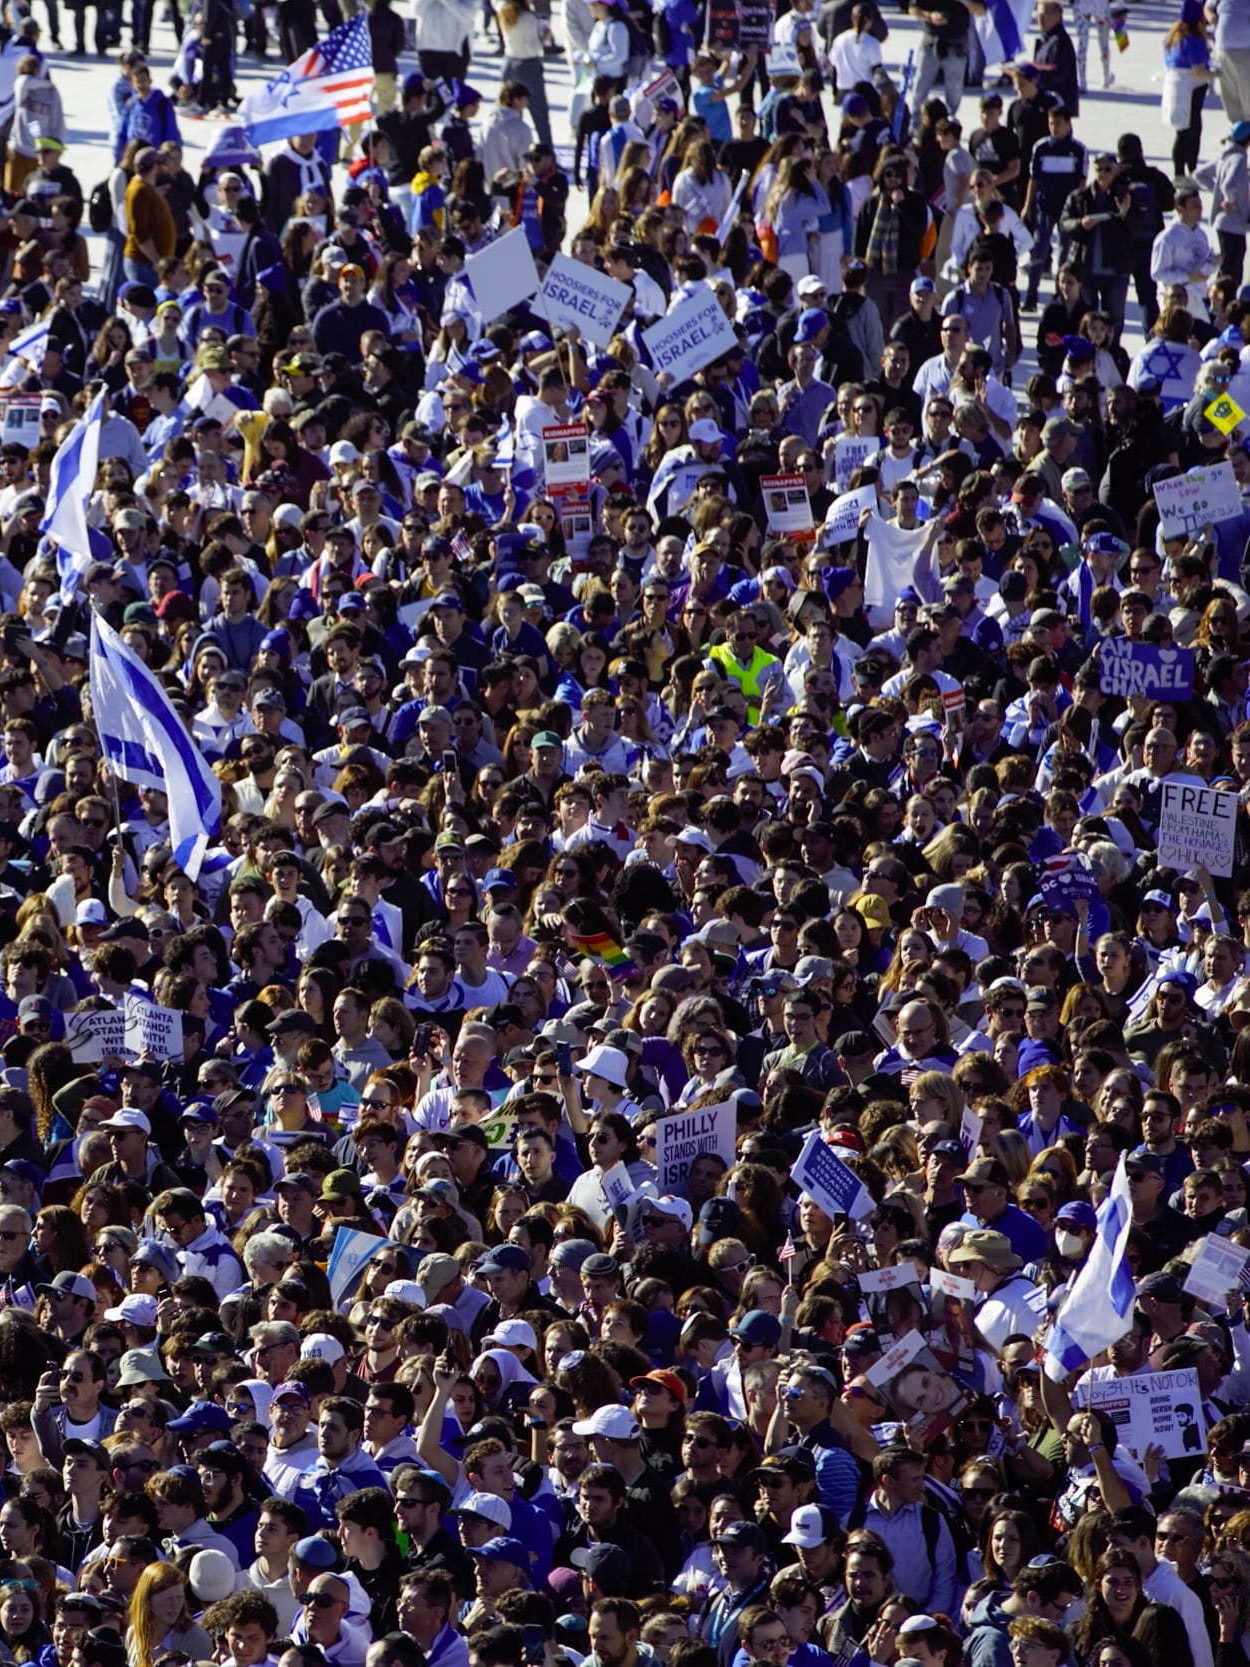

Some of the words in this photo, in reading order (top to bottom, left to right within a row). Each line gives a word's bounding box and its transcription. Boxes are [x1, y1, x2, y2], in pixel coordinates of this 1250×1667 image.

[550, 270, 600, 300] HOOSIERS
[600, 294, 622, 312] FOR
[543, 281, 597, 320] ISRAEL
[651, 316, 698, 354] HOOSIERS
[697, 303, 718, 321] FOR
[657, 327, 712, 369] ISRAEL
[544, 428, 586, 438] KIDNAPPED
[763, 478, 804, 487] KIDNAPPED
[1100, 638, 1133, 660] AM
[1100, 654, 1189, 689] YISRAEL
[1165, 784, 1230, 819] FREE
[1161, 821, 1189, 835] FROM
[1162, 812, 1219, 831] PALESTINE
[1161, 832, 1182, 845] THE
[1041, 880, 1058, 892] DC
[89, 1016, 125, 1026] ATLAN
[137, 1005, 174, 1024] ATLANTA
[93, 1026, 125, 1036] STAN
[138, 1017, 171, 1034] STANDS
[103, 1036, 125, 1045] WIT
[143, 1031, 165, 1043] WITH
[664, 1111, 717, 1144] PHILLY
[664, 1139, 696, 1163] STANDS
[697, 1133, 718, 1152] WITH
[664, 1162, 689, 1187] ISR
[821, 1149, 853, 1185] BOSTON
[1130, 1379, 1149, 1394] It's
[1150, 1374, 1175, 1393] NOT
[1150, 1395, 1171, 1405] BRING
[1151, 1405, 1173, 1414] HERSH
[1153, 1414, 1172, 1424] HOME
[1154, 1424, 1174, 1433] NOW!
